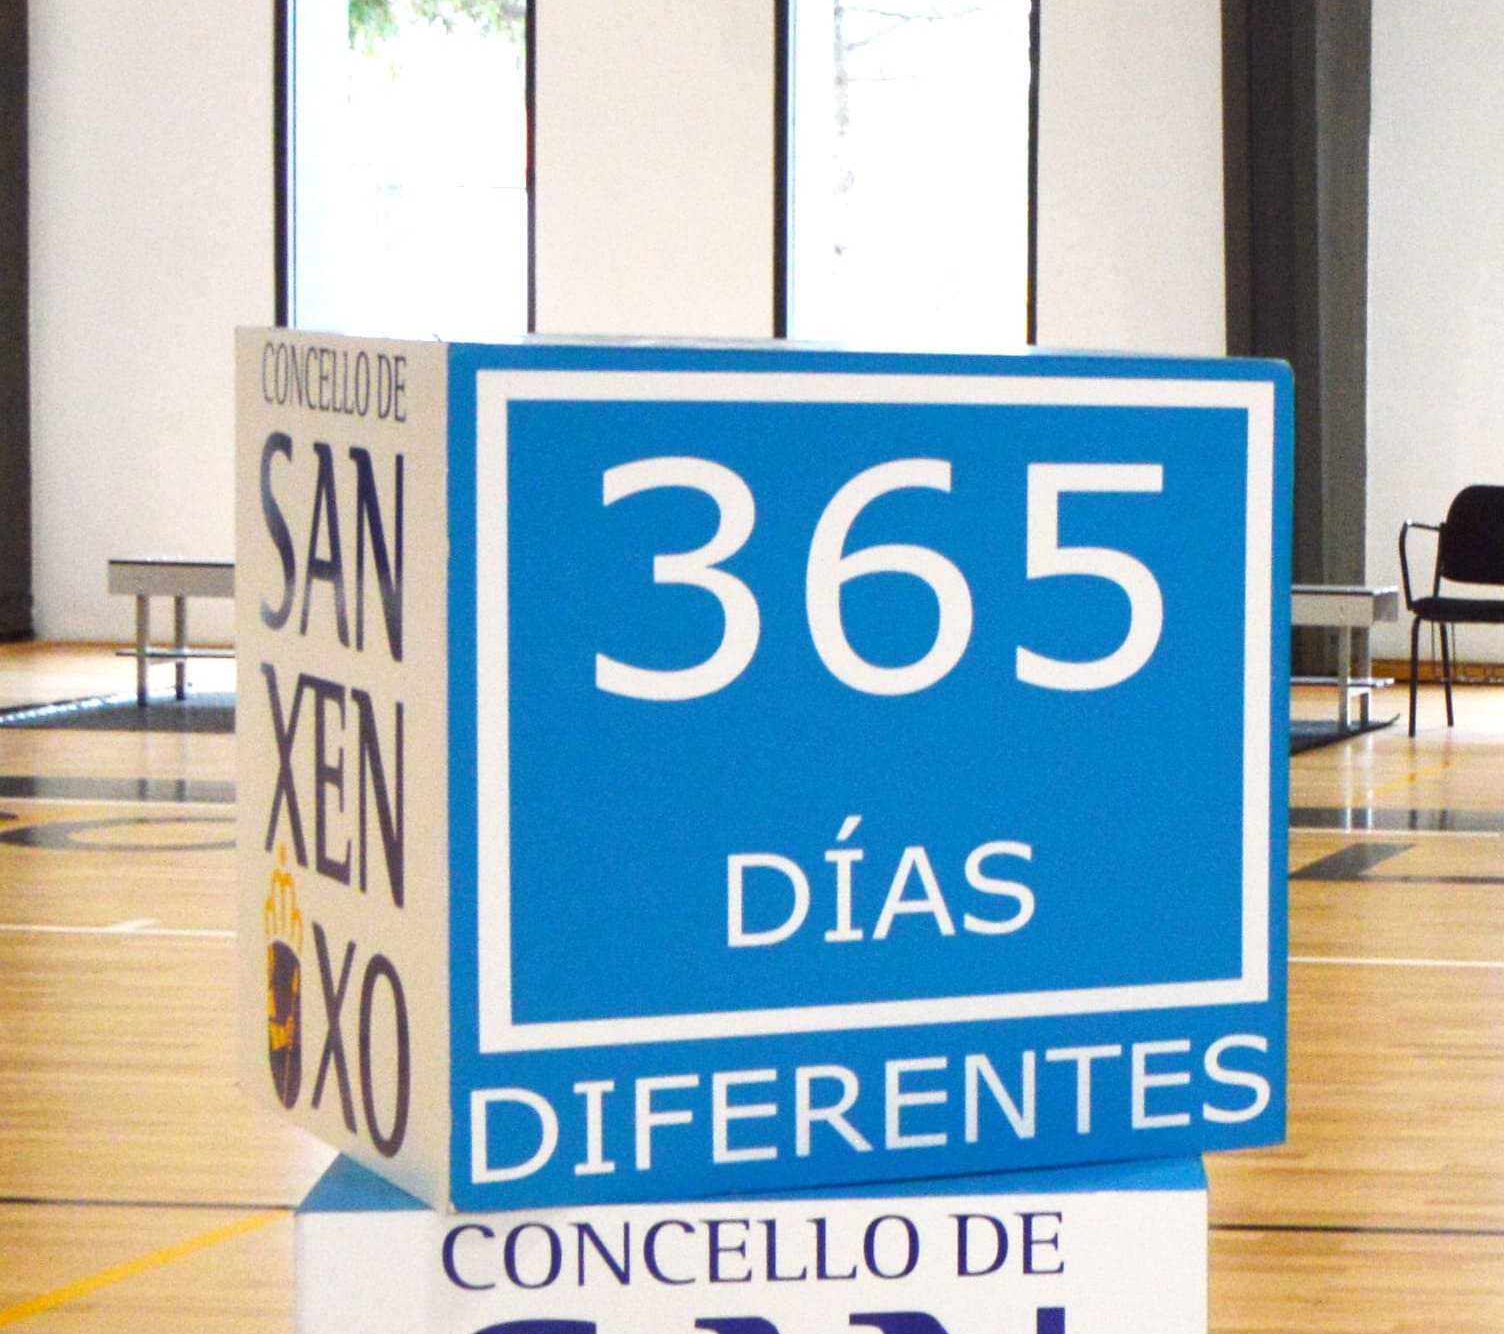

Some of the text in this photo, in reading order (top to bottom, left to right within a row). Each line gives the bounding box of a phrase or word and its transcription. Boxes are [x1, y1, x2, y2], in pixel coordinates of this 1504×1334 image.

[261, 340, 408, 423] CONCELLO DE
[260, 431, 405, 664] SAN
[594, 455, 1165, 702] 365
[261, 662, 405, 909] XEN
[726, 815, 1036, 949] DÍAS
[311, 922, 412, 1160] XO
[469, 1033, 1272, 1186] DIFERENTES
[440, 1211, 1066, 1292] CONCELLO DE
